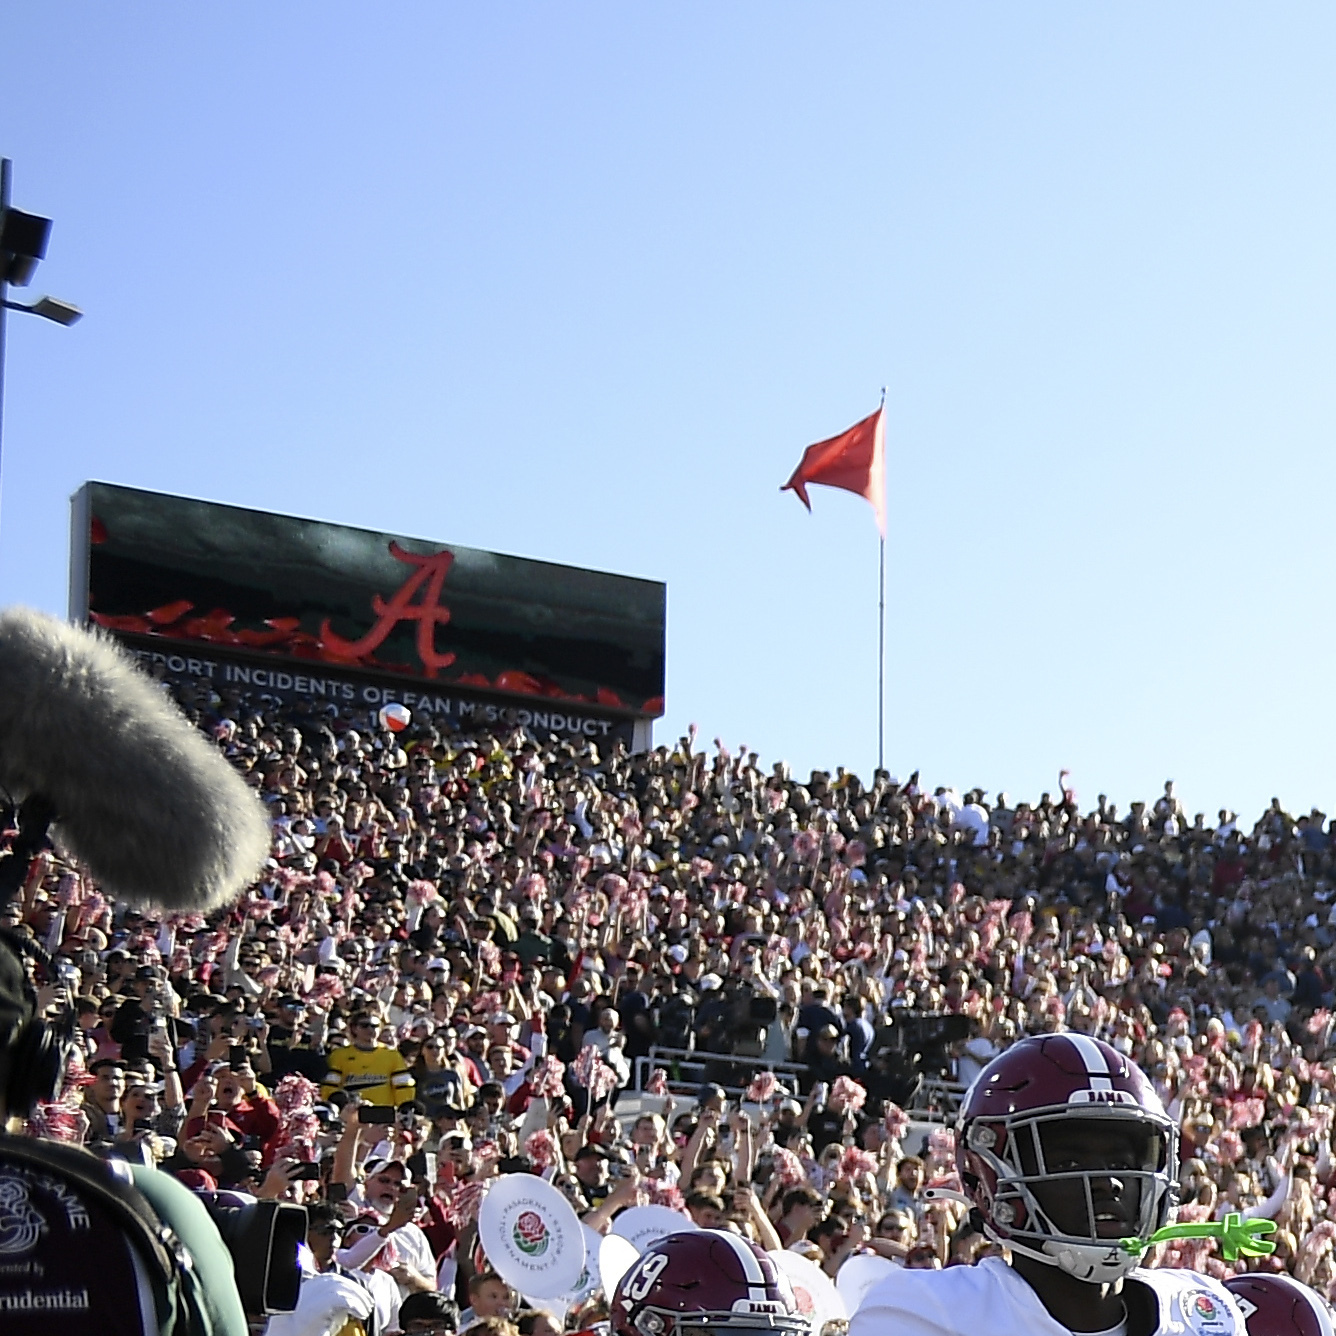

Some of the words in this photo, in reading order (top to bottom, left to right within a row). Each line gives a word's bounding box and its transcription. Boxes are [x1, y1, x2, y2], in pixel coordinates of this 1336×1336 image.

[226, 665, 354, 700] INCIDENTS
[363, 687, 395, 703] OF
[403, 691, 450, 713] FAN
[1089, 1091, 1124, 1103] BAMA
[622, 1250, 669, 1300] 19
[749, 1303, 777, 1313] BAMA
